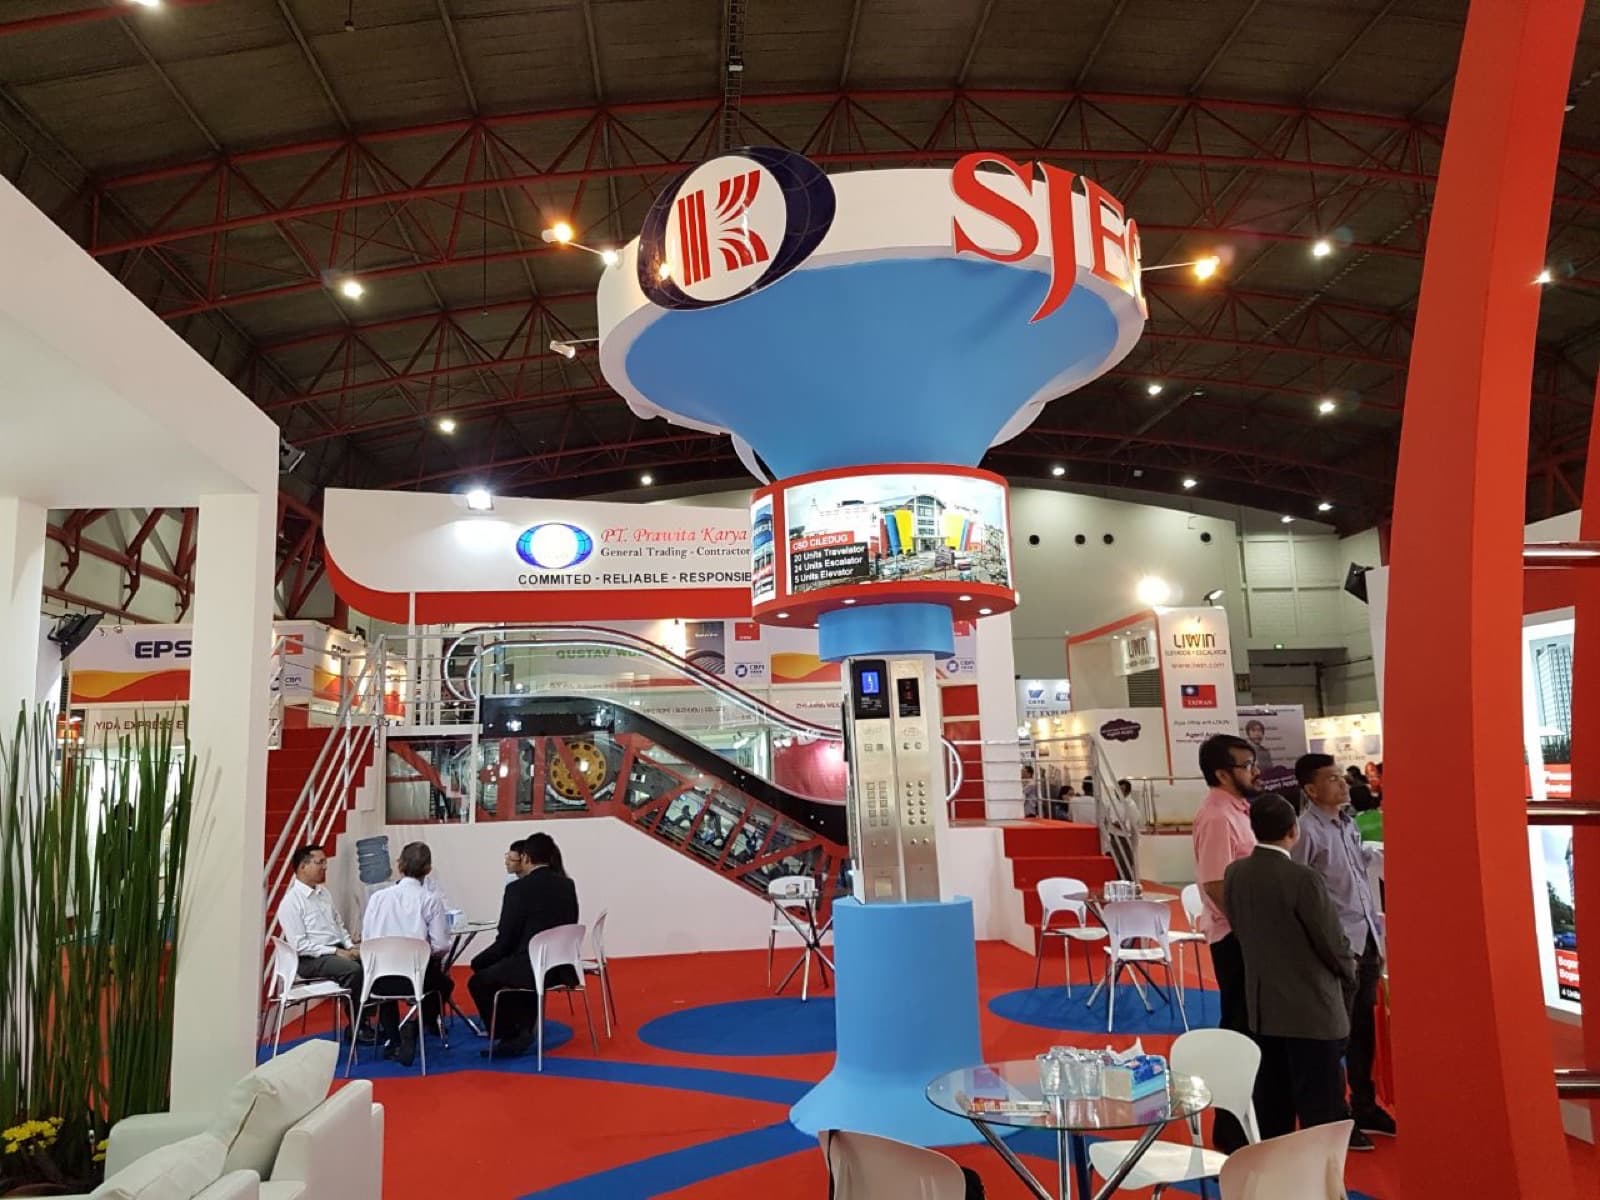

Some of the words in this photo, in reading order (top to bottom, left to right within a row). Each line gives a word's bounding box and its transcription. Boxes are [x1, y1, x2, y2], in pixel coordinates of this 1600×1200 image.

[600, 527, 628, 543] PT.
[633, 527, 696, 543] Prawita
[700, 526, 748, 546] Karya
[809, 533, 848, 547] CILEDUG
[600, 546, 642, 557] General
[646, 546, 687, 559] Trading
[803, 551, 822, 562] Units
[824, 544, 866, 557] Travelator
[804, 561, 823, 572] Units
[825, 555, 864, 568] Escalator
[518, 573, 592, 585] COMMITED
[603, 572, 668, 584] RELIABLE
[800, 571, 819, 582] Units
[820, 567, 854, 579] Elevator
